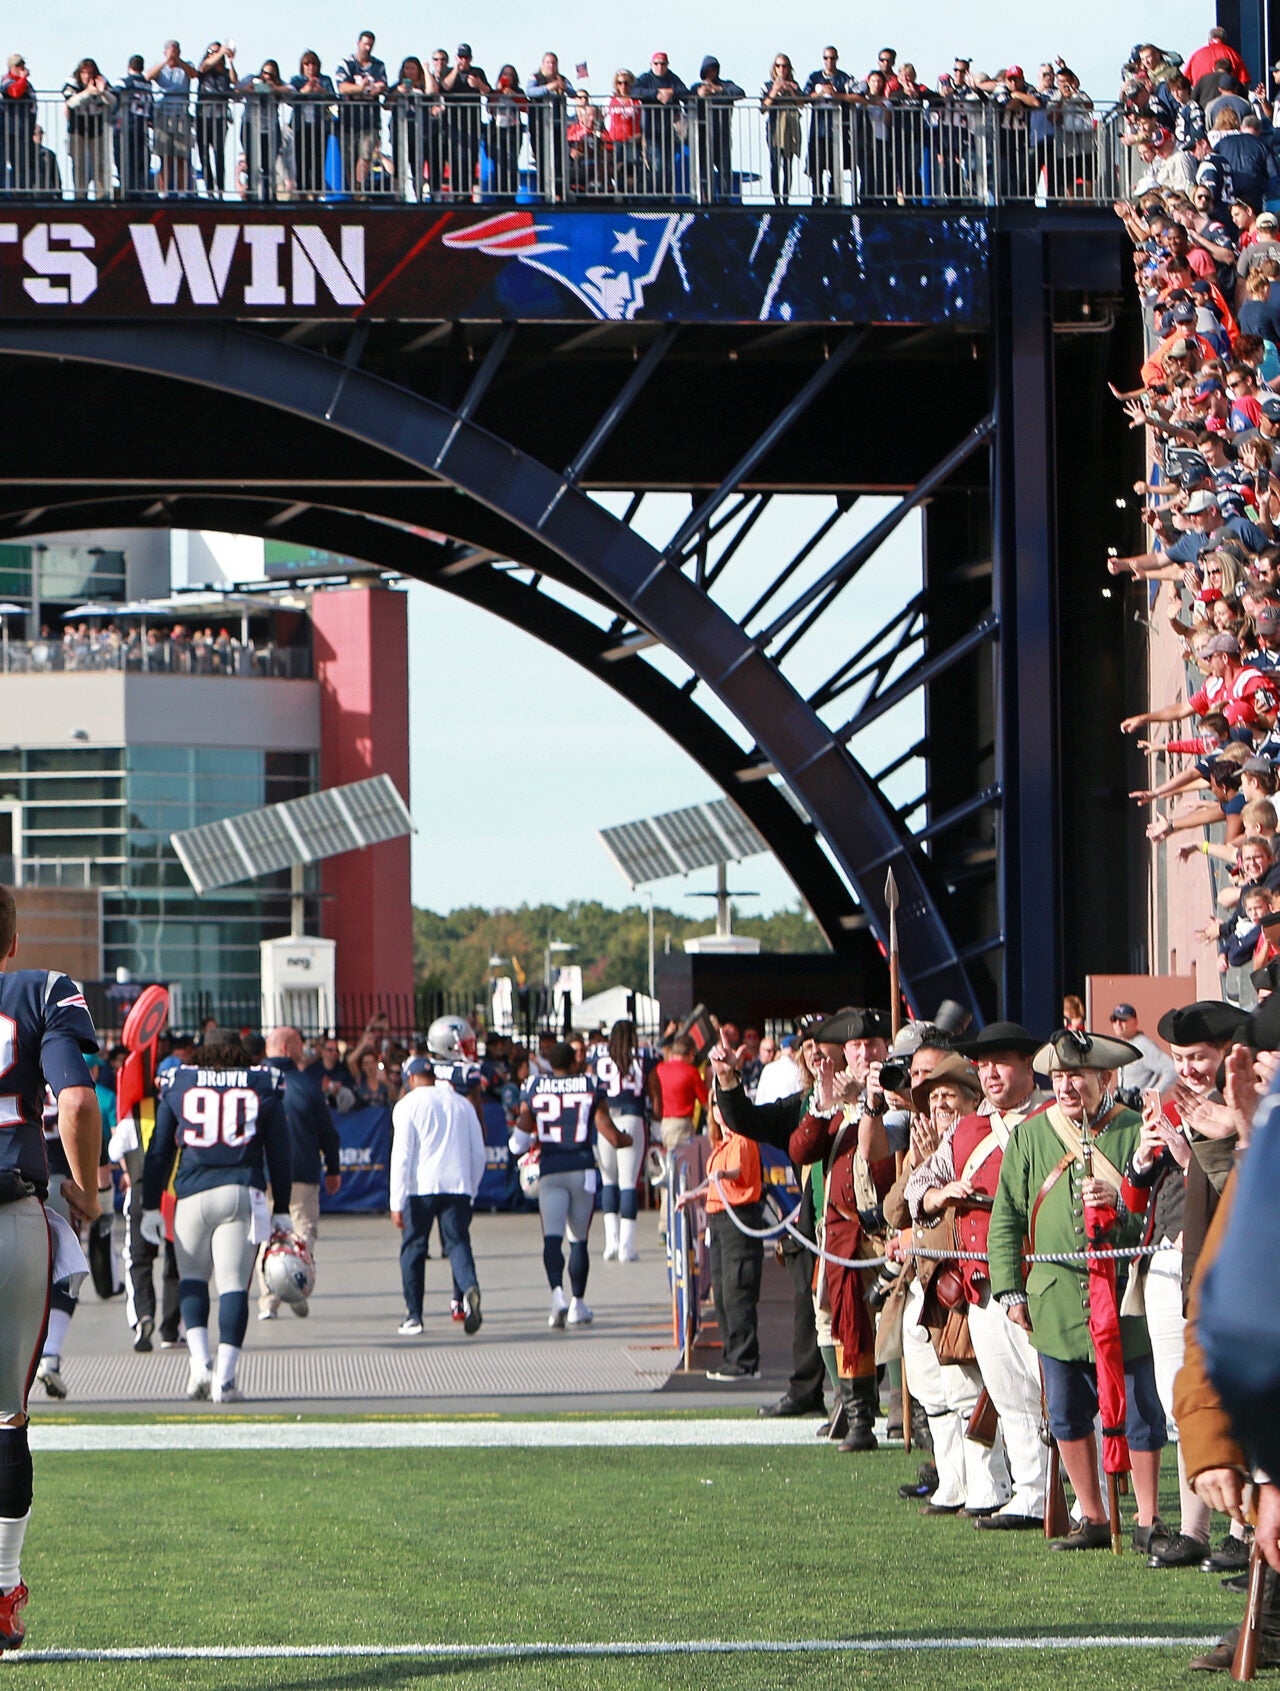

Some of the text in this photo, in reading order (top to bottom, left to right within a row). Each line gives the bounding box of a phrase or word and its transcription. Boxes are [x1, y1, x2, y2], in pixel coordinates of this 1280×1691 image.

[128, 223, 366, 306] WIN
[197, 1070, 248, 1087] BROWN
[536, 1077, 588, 1093] JACKSON
[596, 1056, 643, 1098] 94
[182, 1087, 259, 1148] 90
[532, 1093, 593, 1143] 27
